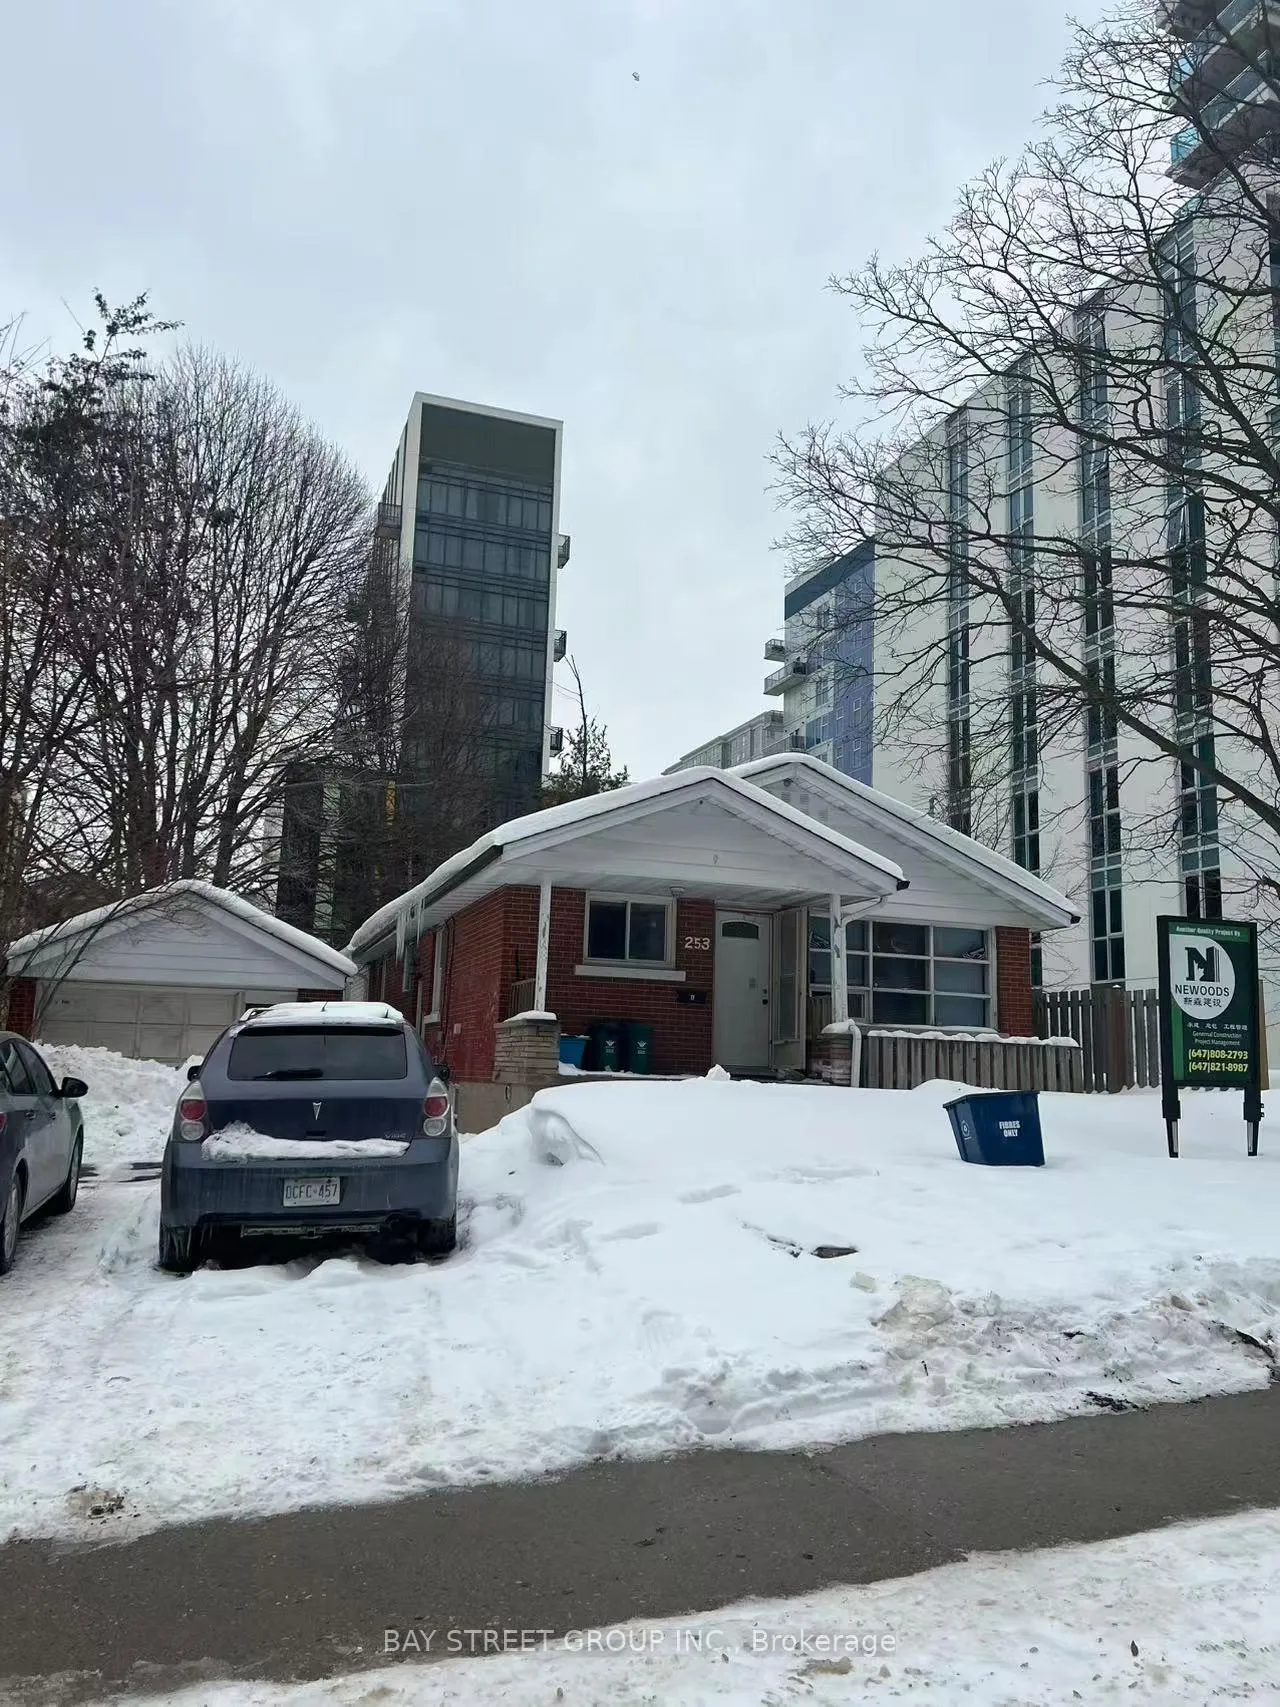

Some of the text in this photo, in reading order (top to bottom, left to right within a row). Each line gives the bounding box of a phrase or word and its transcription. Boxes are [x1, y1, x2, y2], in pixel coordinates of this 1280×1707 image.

[685, 936, 711, 951] 253
[1175, 984, 1230, 997] NEWOODS
[1188, 1049, 1249, 1061] (647)808-2793
[1188, 1062, 1249, 1074] (647)821-8987
[1003, 1129, 1018, 1138] ONLY
[318, 1183, 338, 1198] 457
